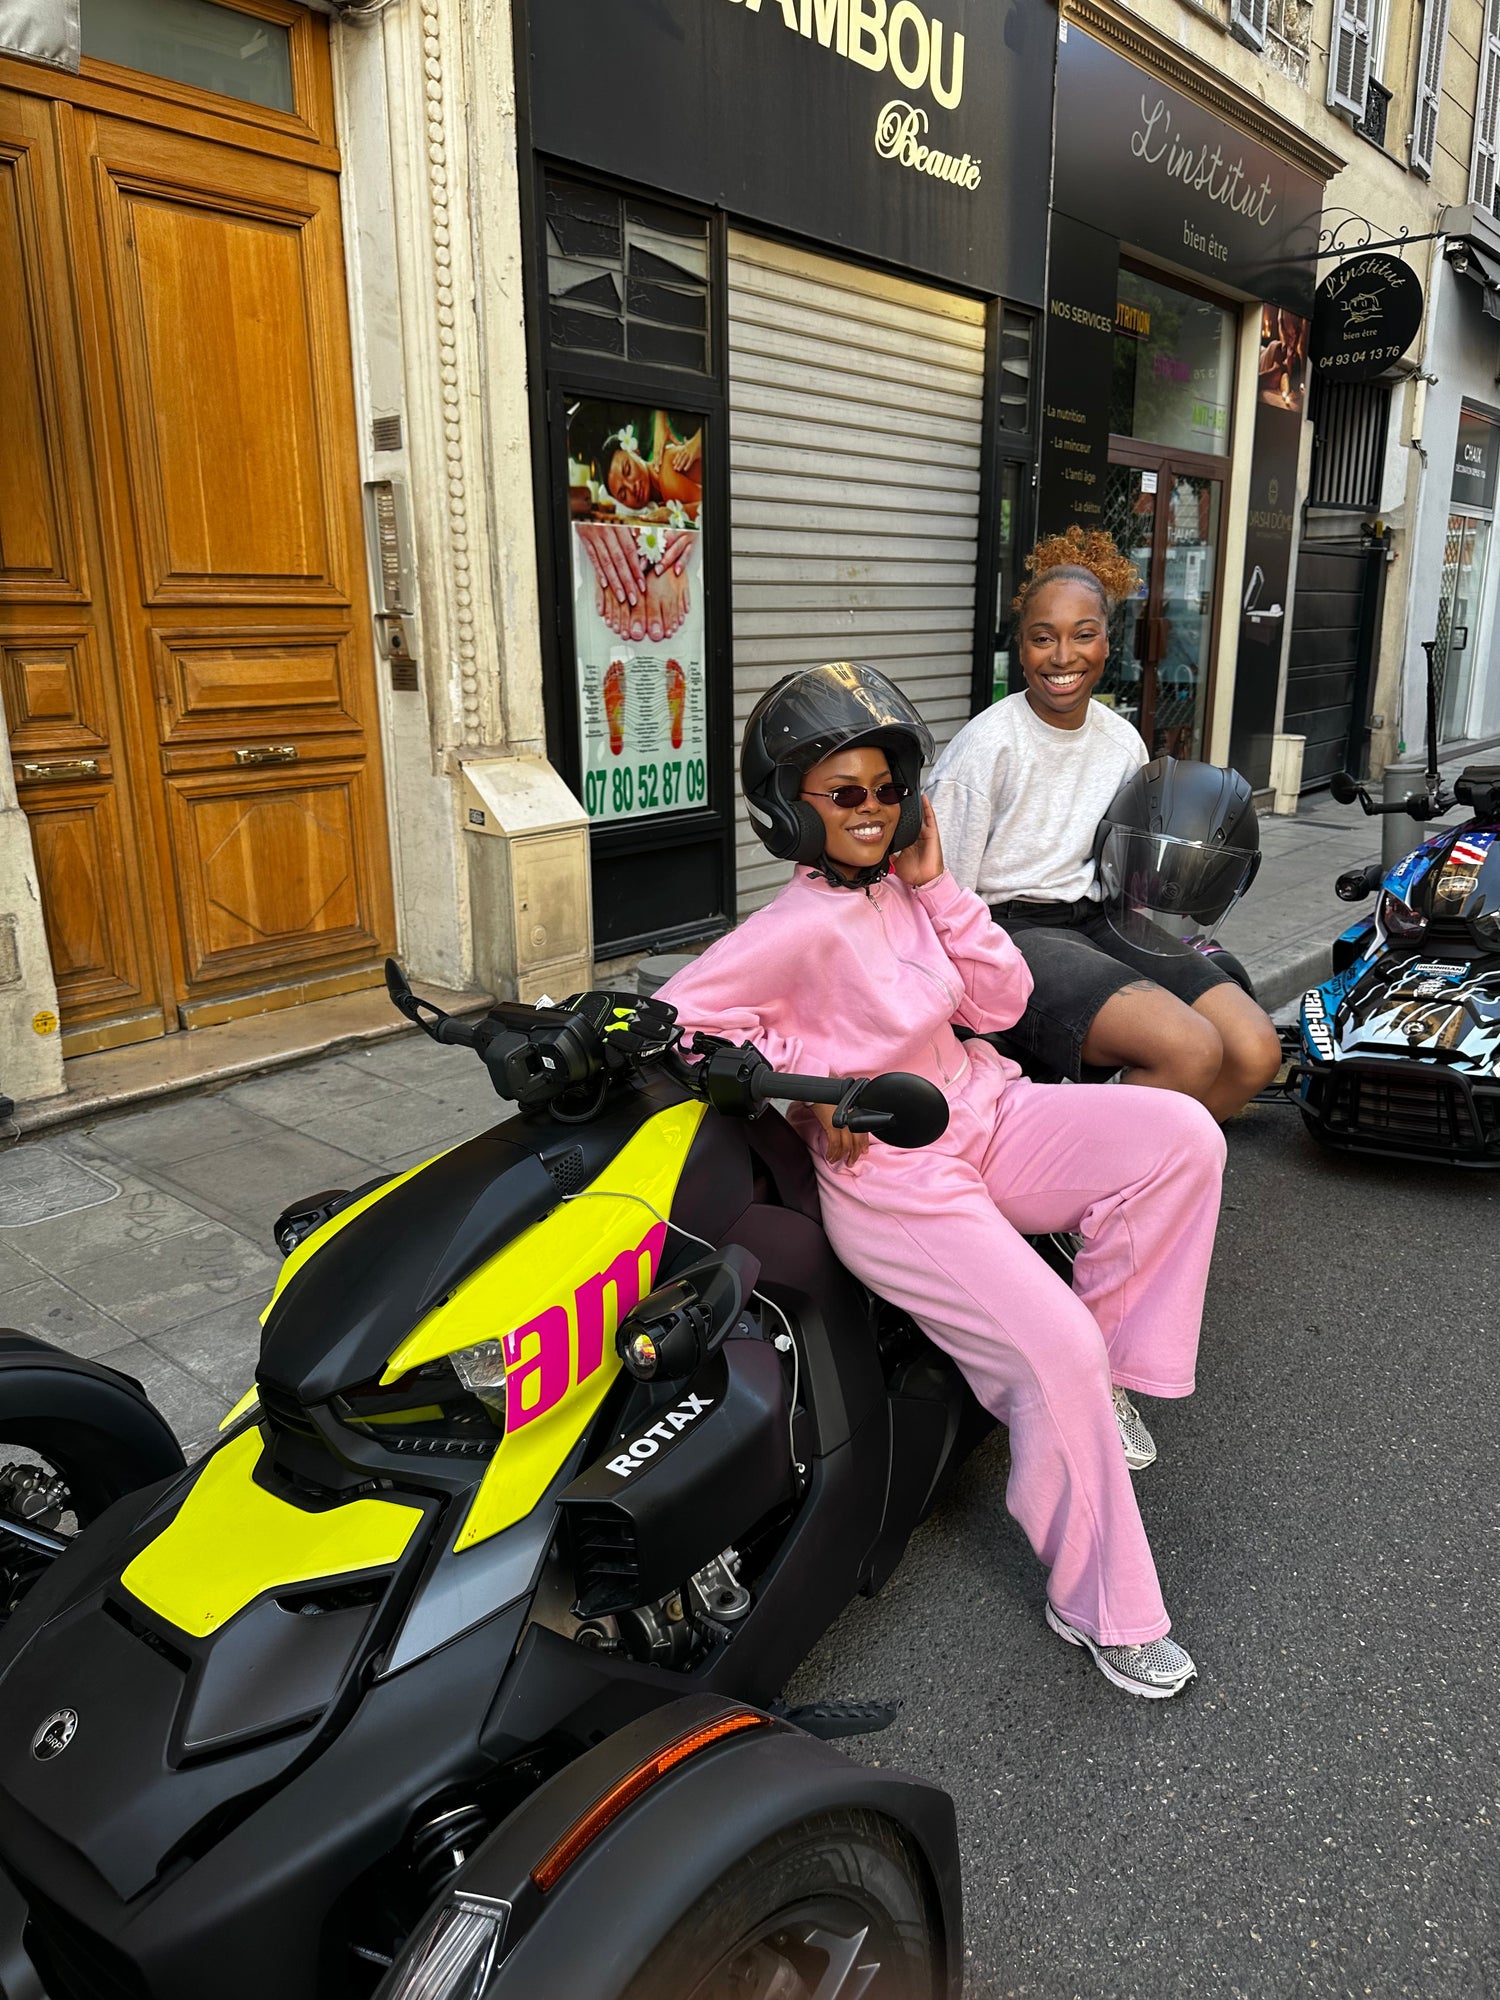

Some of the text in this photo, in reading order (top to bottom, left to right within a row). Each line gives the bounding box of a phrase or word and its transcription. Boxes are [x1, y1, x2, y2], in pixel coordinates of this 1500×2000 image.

[727, 0, 965, 110] MBOU
[1131, 94, 1277, 226] L'institut
[1183, 220, 1228, 262] bien être
[1325, 258, 1406, 300] L'institut
[1050, 299, 1112, 333] NOS SERVICES
[1343, 332, 1360, 341] bien
[1320, 345, 1400, 368] 04 93 04 13 76
[1047, 404, 1086, 424] La nutrition
[1054, 436, 1091, 454] La minceur
[1065, 467, 1082, 482] L'anti
[1074, 500, 1082, 512] La
[585, 758, 705, 816] 07 80 52 87 09
[1305, 989, 1335, 1061] can-am
[502, 1221, 669, 1434] am
[605, 1392, 715, 1478] ROTAX
